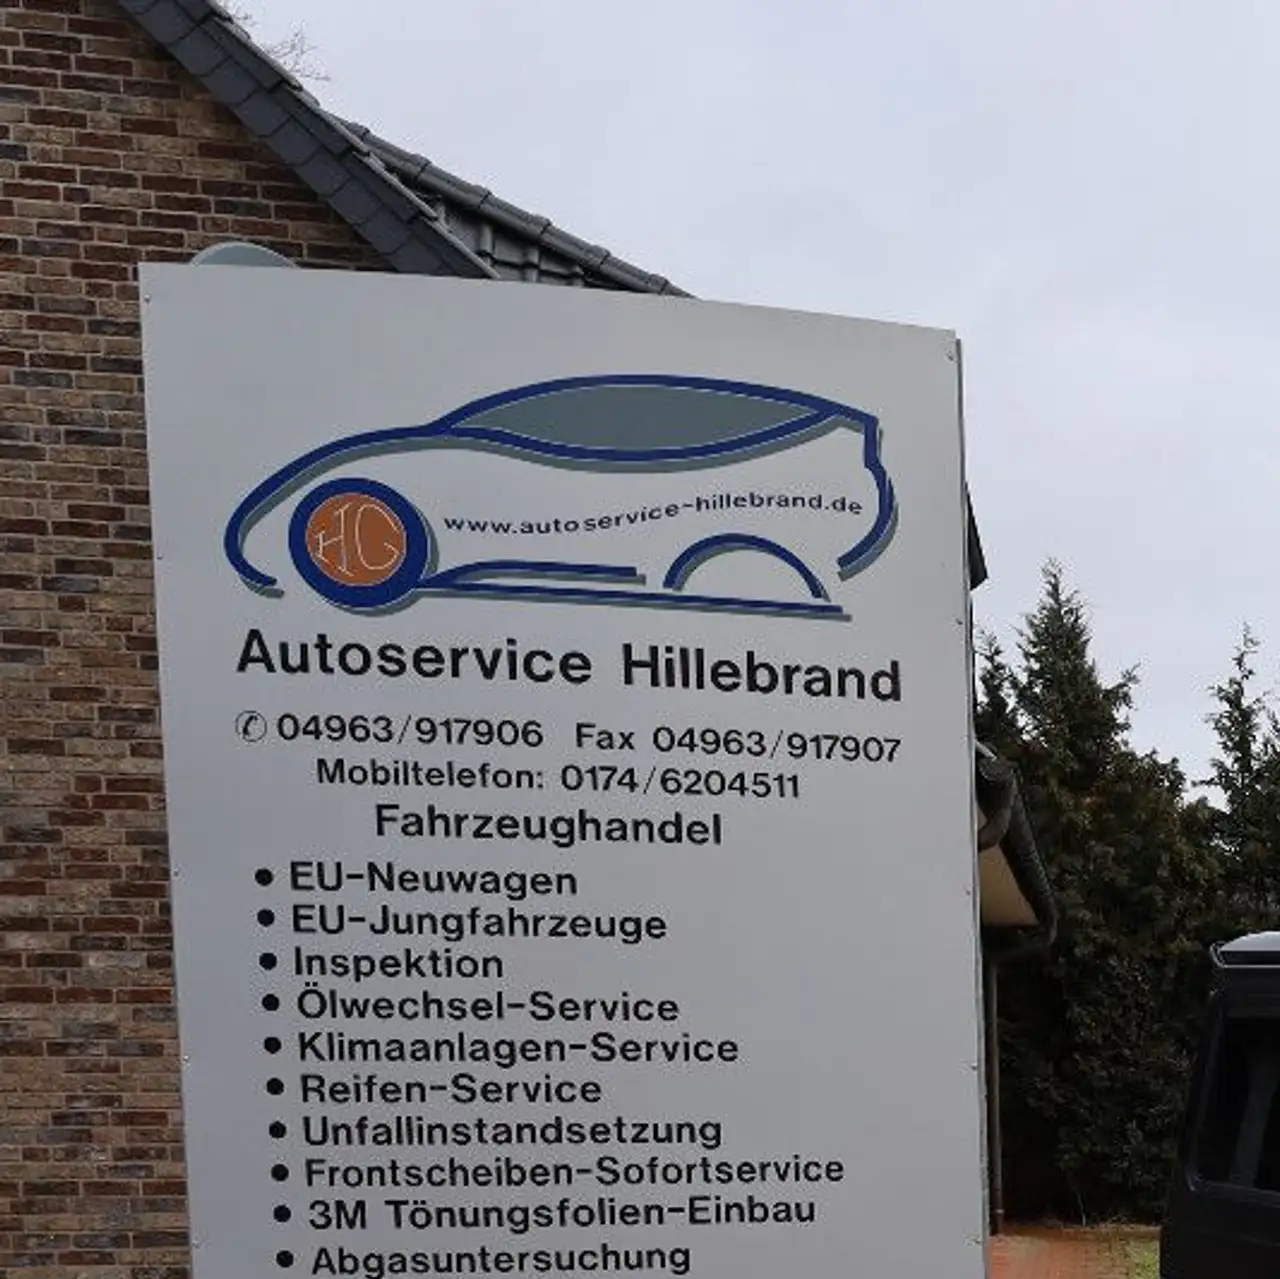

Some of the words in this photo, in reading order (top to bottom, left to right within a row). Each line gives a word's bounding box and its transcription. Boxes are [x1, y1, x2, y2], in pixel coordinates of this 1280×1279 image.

[443, 490, 864, 536] www.autoservice-hillebrand.de
[236, 628, 592, 686] Autoservice
[622, 642, 902, 702] Hillebrand
[276, 712, 544, 749] 04963/917906
[575, 722, 635, 751] Fax
[652, 726, 902, 763] 04963/917907
[316, 757, 544, 792] Mobiltelefon:
[560, 763, 799, 799] 0174/6204511
[375, 803, 722, 850] Fahrzeughandel
[289, 860, 579, 903] EU-Neuwagen
[292, 903, 668, 945] EU-Jungfahrzeuge
[294, 945, 505, 984] Inspektion
[296, 981, 681, 1023] Ölwechsel-Service
[297, 1031, 740, 1070] Klimaanlagen-Service
[299, 1072, 603, 1106] Reifen-Service
[301, 1114, 723, 1151] Unfallinstandsetzung
[304, 1154, 845, 1189] Frontscheiben-Sofortservice
[308, 1198, 368, 1232] 3M
[385, 1194, 816, 1236] Tönungsfolien-Einbau
